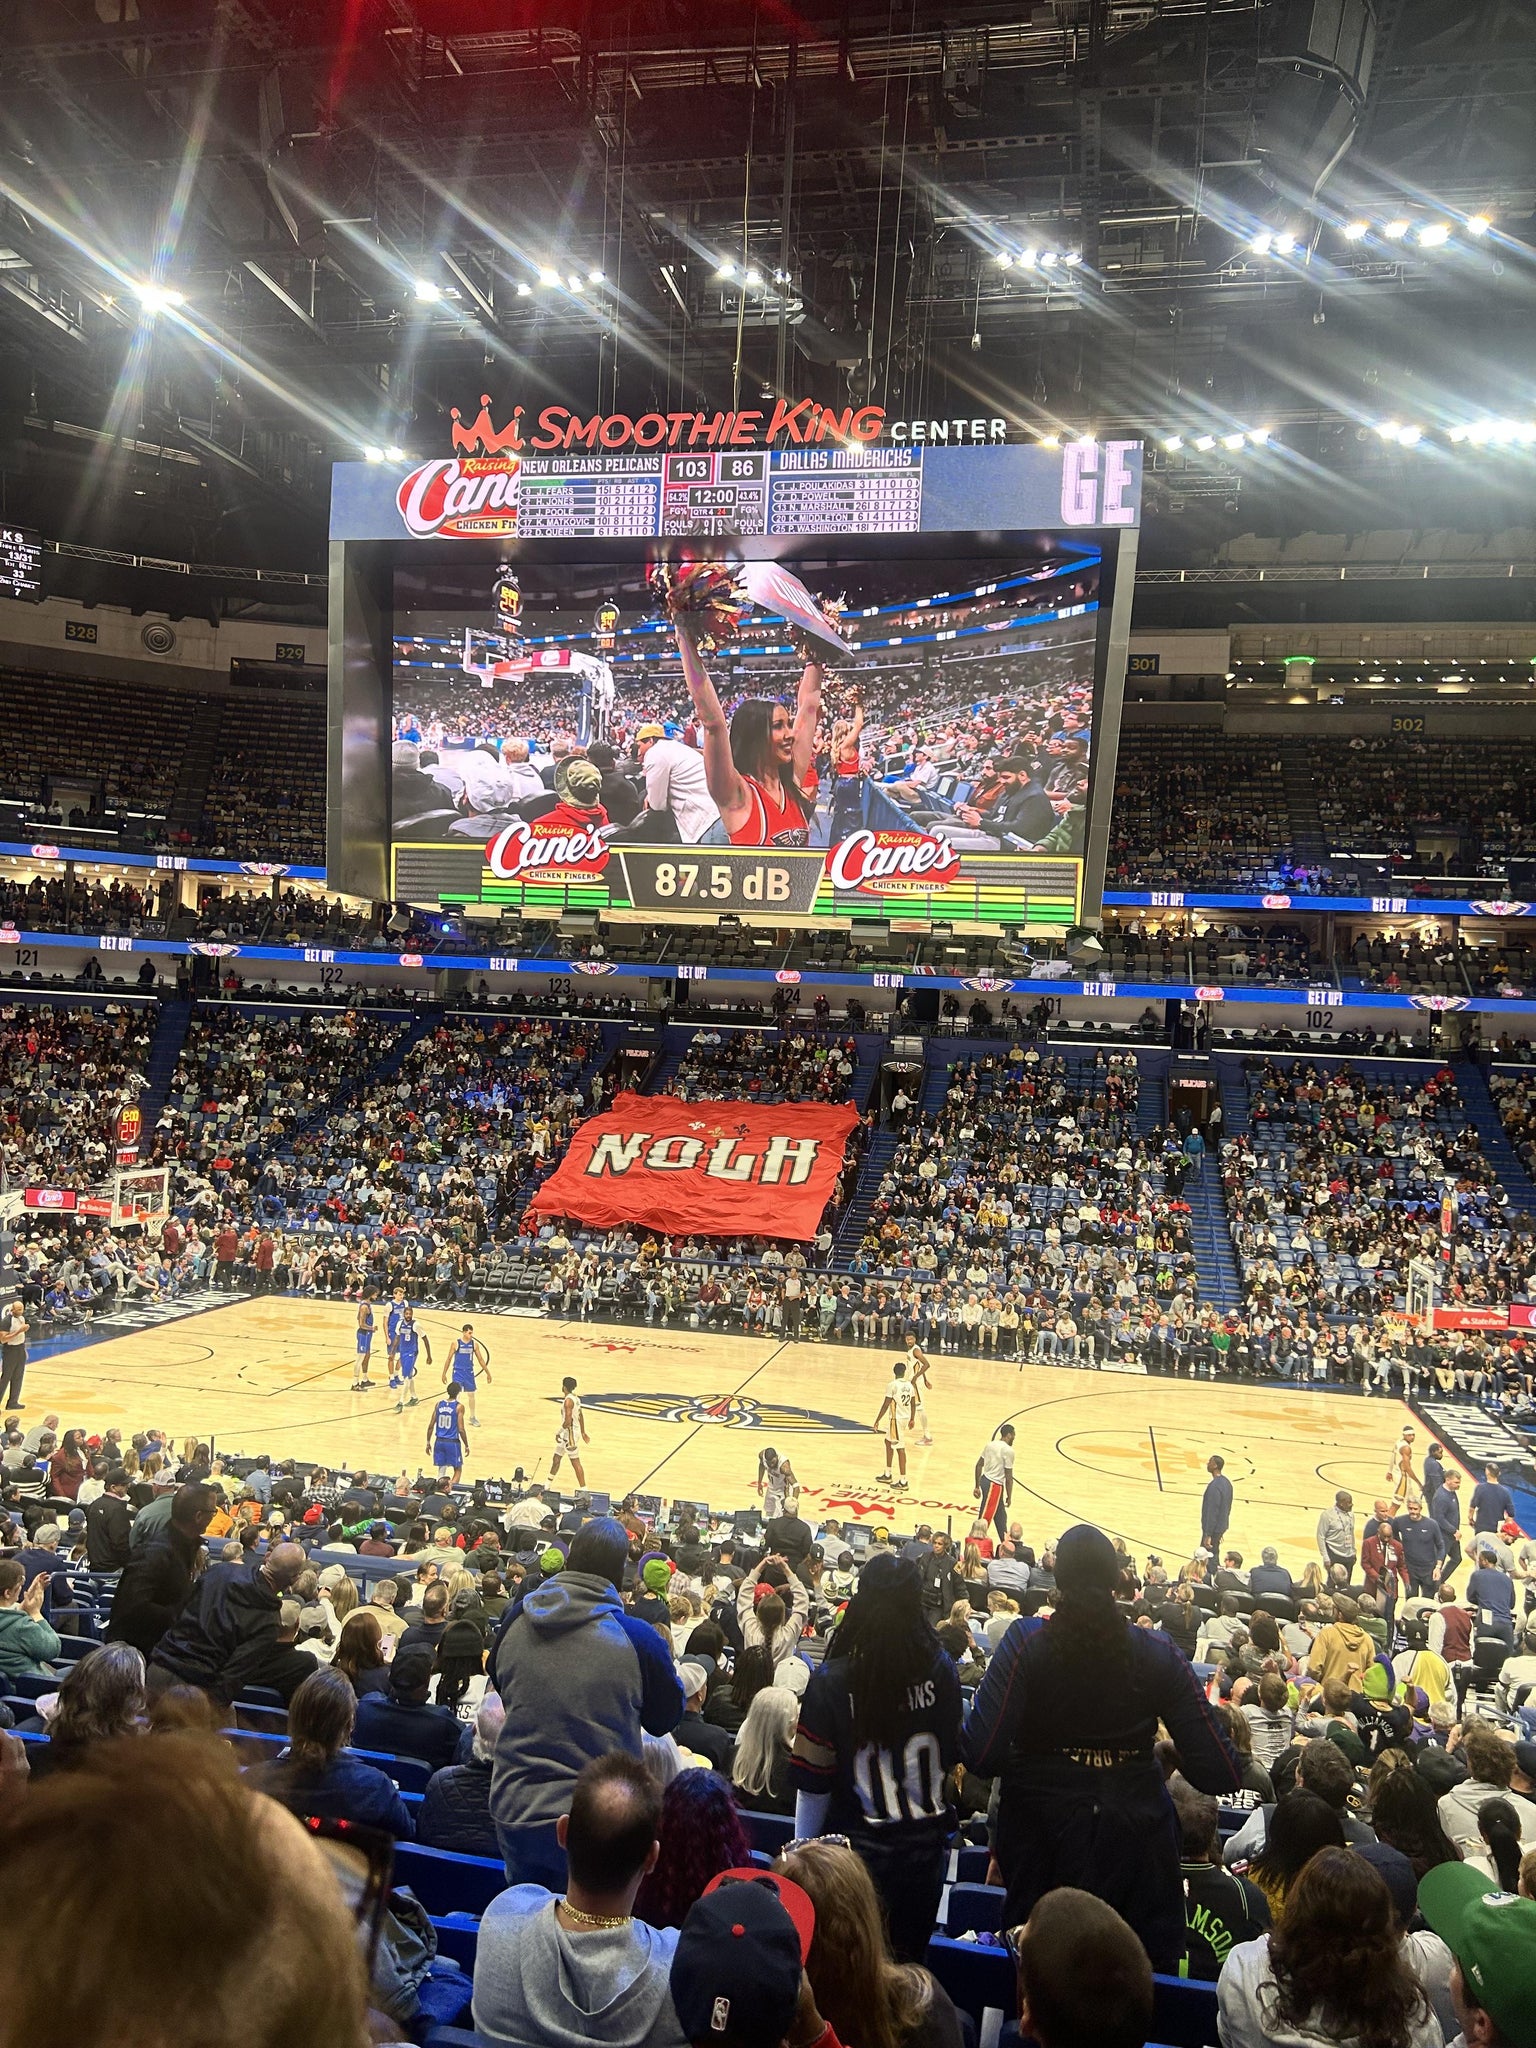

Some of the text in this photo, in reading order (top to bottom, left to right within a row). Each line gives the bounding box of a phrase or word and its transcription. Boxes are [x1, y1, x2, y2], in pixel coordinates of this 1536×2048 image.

[530, 404, 763, 450] SMOOTHIE
[891, 418, 1007, 441] CENTER
[522, 458, 660, 474] NEW ORLEANS PELICANS
[780, 449, 912, 470] DALLAS MAVERICKS
[463, 459, 517, 475] Raising
[676, 460, 706, 478] 103
[732, 460, 754, 476] 86
[800, 482, 854, 490] POULAKIDAS
[644, 496, 649, 504] 1
[694, 490, 734, 503] 12:00
[738, 491, 758, 500] 43.4%
[670, 507, 687, 515] FG%
[740, 506, 758, 514] FG%
[790, 503, 799, 511] N.
[801, 502, 850, 510] MARSHALL
[856, 502, 866, 510] 26
[906, 501, 912, 509] 2
[629, 517, 634, 525] 1
[858, 512, 864, 520] 6
[890, 512, 894, 520] 1
[904, 512, 910, 520] 2
[456, 520, 498, 530] CHICKEN
[734, 519, 764, 528] FOULS
[798, 524, 853, 532] WASHINGTON
[856, 524, 866, 532] 18
[872, 523, 878, 531] 7
[905, 522, 910, 530] 1
[8, 551, 33, 563] 13/31
[12, 570, 24, 578] 33
[14, 588, 21, 596] 7
[66, 624, 96, 640] 328
[278, 646, 304, 659] 329
[1131, 658, 1156, 672] 301
[1392, 718, 1424, 732] 302
[533, 824, 574, 838] Raising
[878, 832, 921, 846] Raising
[490, 821, 610, 880] Cane's
[156, 856, 174, 869] GET
[830, 828, 960, 890] Cane's
[529, 871, 596, 881] CHICKEN FINGERS
[656, 863, 790, 900] 87.5 dB
[872, 881, 945, 891] CHICKEN FINGERS
[1152, 892, 1168, 906] GET
[1372, 898, 1390, 912] GET
[100, 936, 116, 950] GET
[16, 949, 38, 966] 121
[304, 948, 320, 962] GET
[490, 958, 504, 970] GET
[320, 968, 344, 984] 122
[678, 966, 694, 979] GET
[548, 978, 571, 994] 123
[874, 974, 890, 987] GET
[1083, 982, 1100, 996] GET
[1308, 991, 1326, 1005] GET
[1306, 1010, 1333, 1028] 102
[120, 1122, 136, 1142] 24
[901, 1394, 910, 1406] 22
[438, 1414, 452, 1429] 00
[1370, 1729, 1378, 1751] 1
